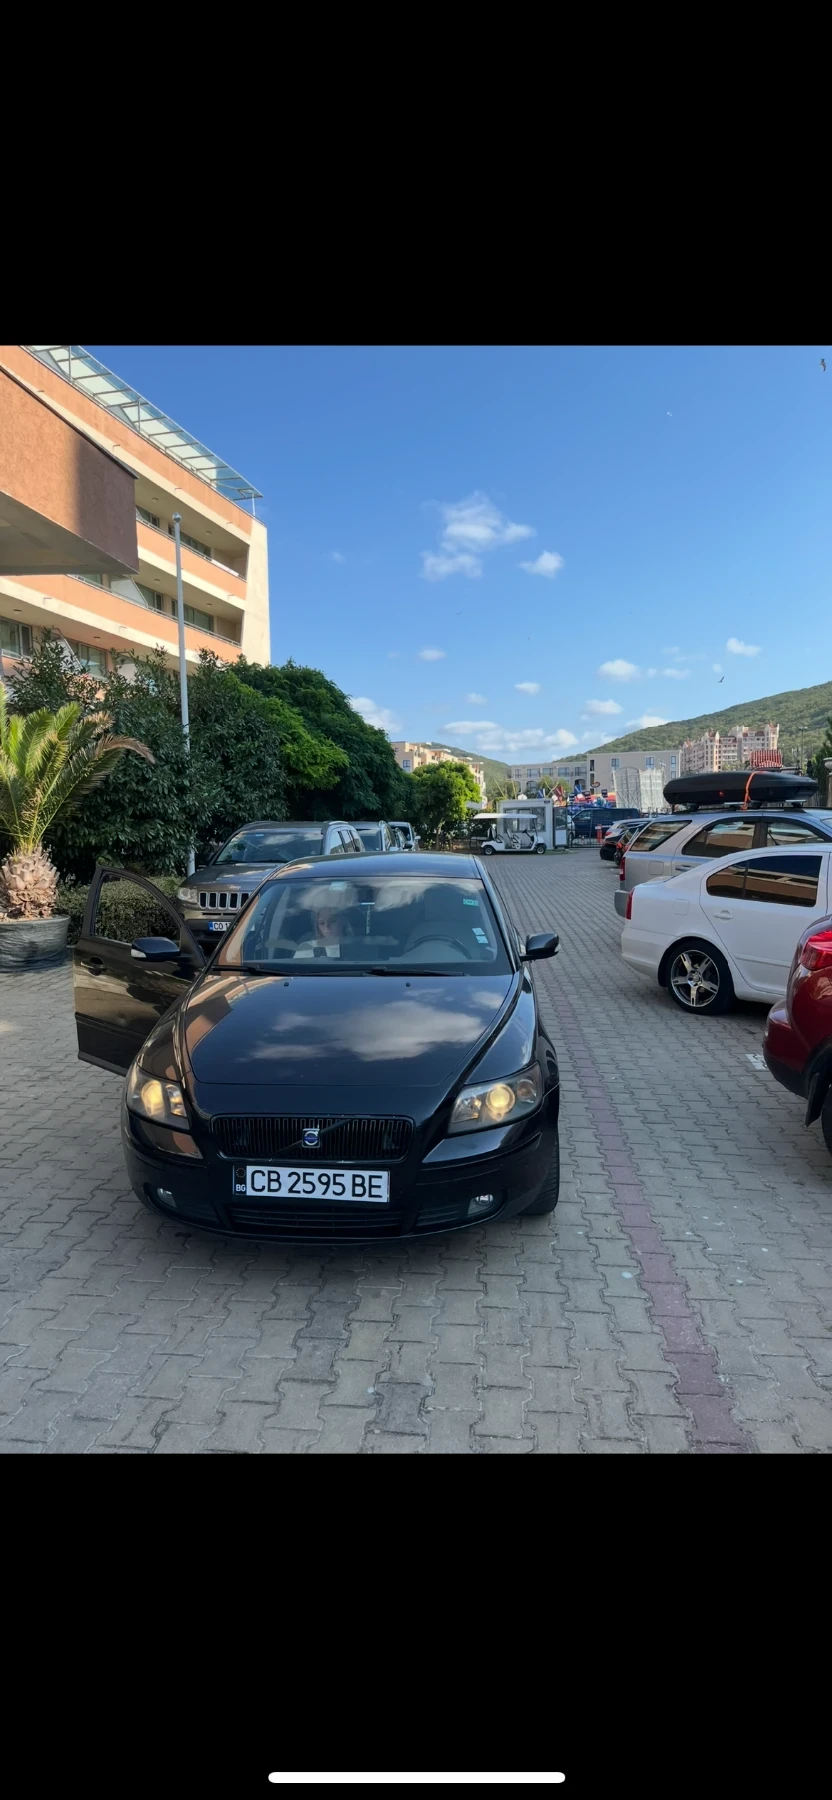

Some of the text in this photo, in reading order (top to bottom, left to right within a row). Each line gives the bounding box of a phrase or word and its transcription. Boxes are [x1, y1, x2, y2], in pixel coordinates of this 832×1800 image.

[213, 922, 224, 930] CO
[235, 1184, 246, 1192] BG
[250, 1169, 383, 1199] CB 2595 BE
